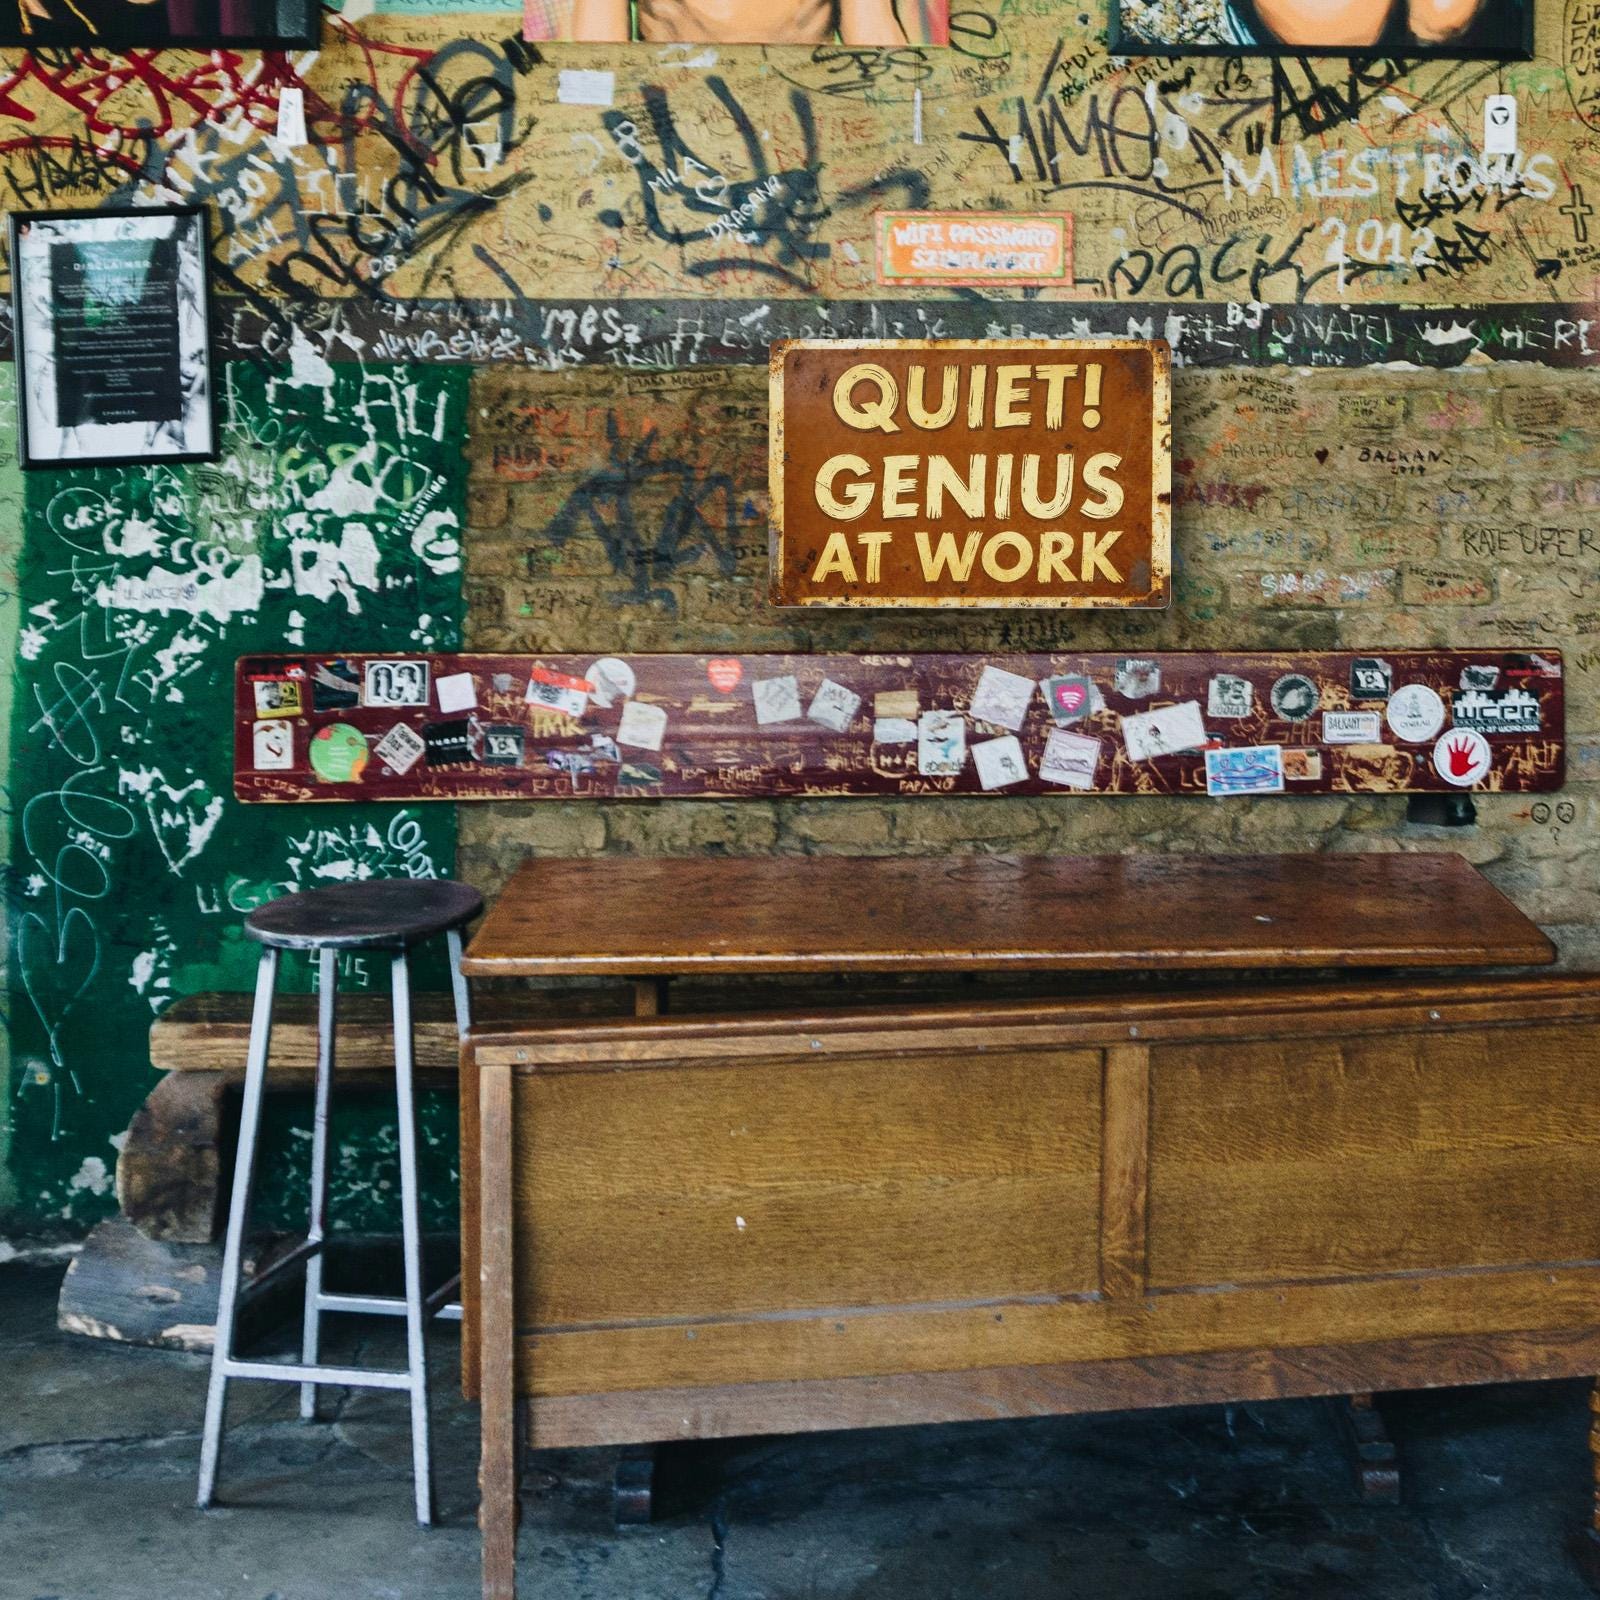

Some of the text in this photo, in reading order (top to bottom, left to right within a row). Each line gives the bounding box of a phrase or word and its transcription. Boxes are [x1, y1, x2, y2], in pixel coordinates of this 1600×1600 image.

[648, 155, 708, 195] MILA
[894, 222, 1057, 248] WIFI PASSWORD
[832, 363, 1103, 433] QUIET!
[814, 453, 1126, 522] GENIUS
[811, 531, 1126, 584] AT WORK
